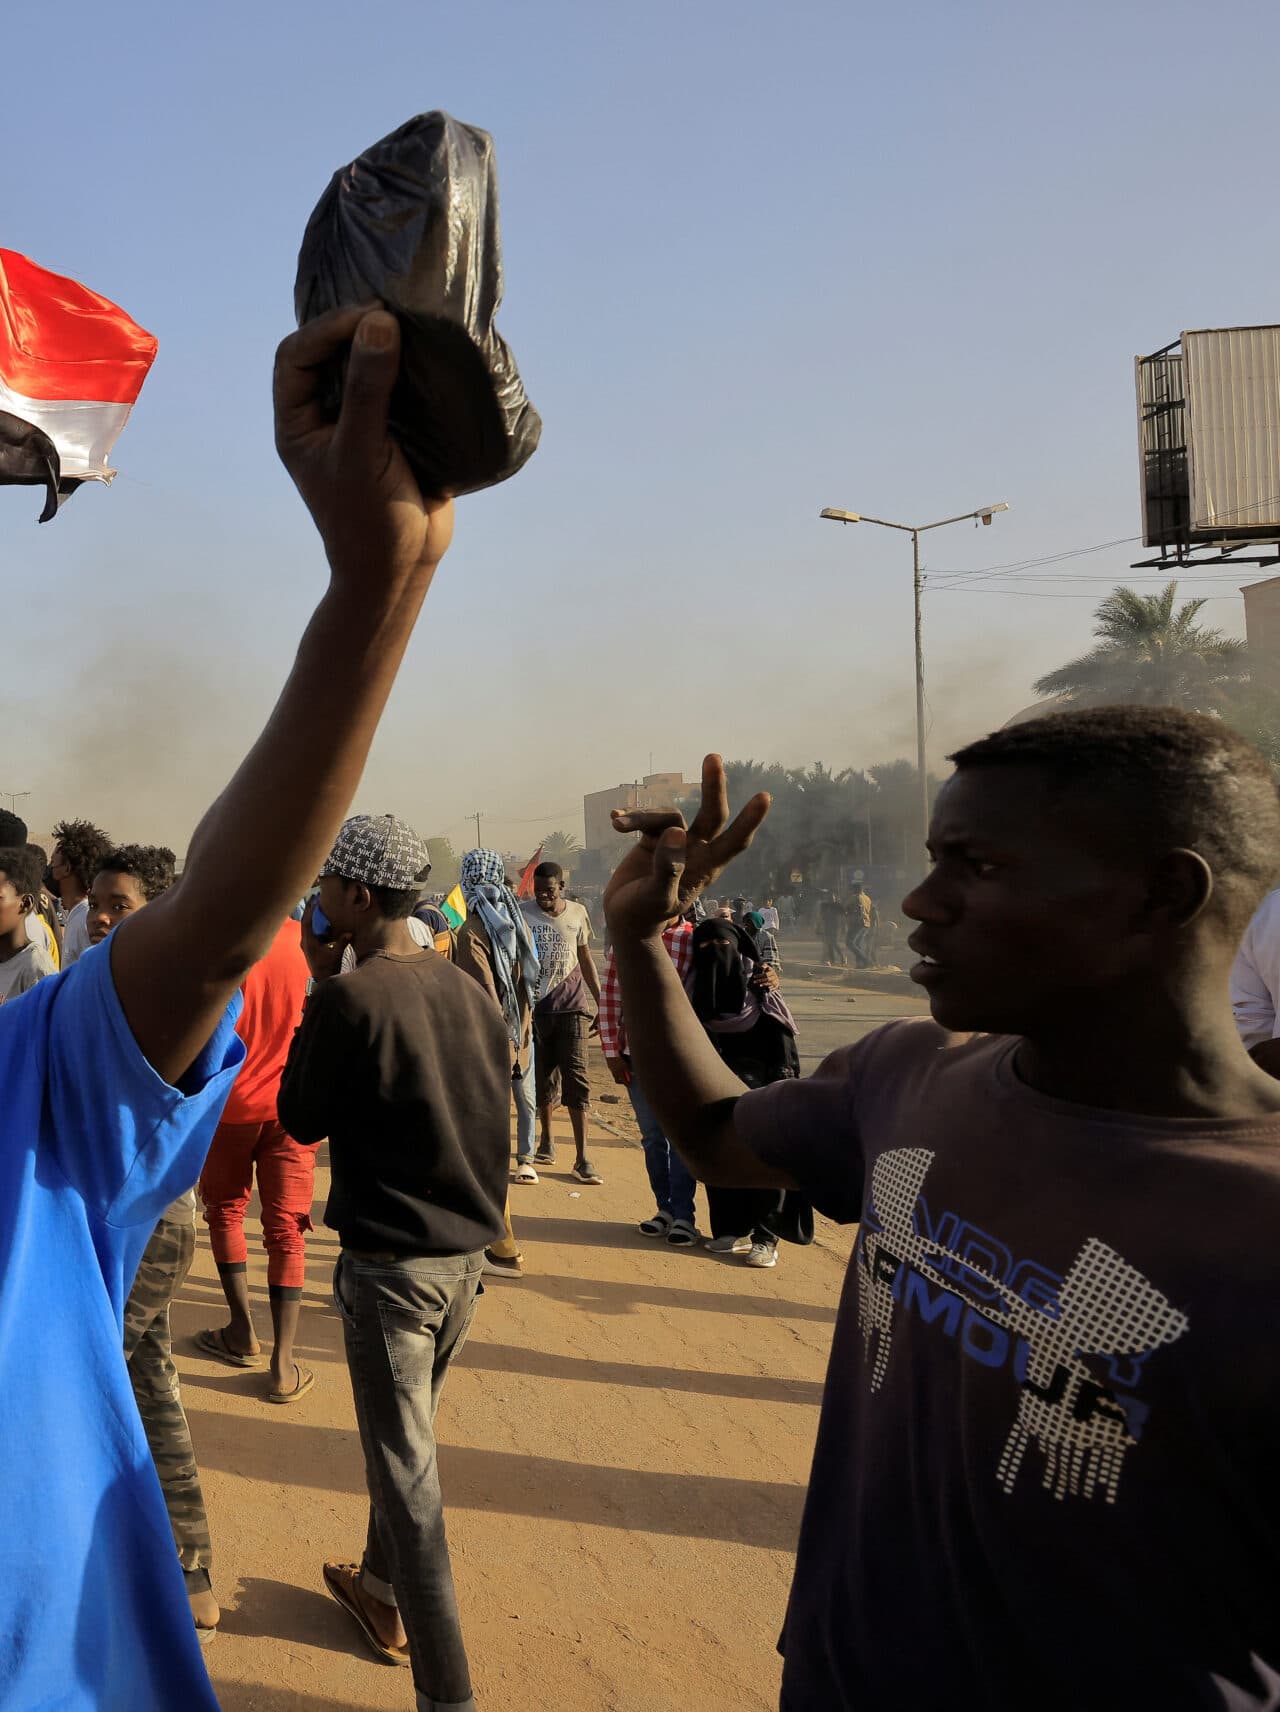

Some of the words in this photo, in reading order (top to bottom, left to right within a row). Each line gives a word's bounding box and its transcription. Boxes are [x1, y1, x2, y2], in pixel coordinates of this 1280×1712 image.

[357, 848, 376, 858] NIKE
[384, 851, 402, 860] NIKE
[345, 854, 361, 864] NIKE
[351, 867, 369, 877] NIKE
[393, 863, 412, 872] NIKE
[378, 871, 398, 880] NIKE
